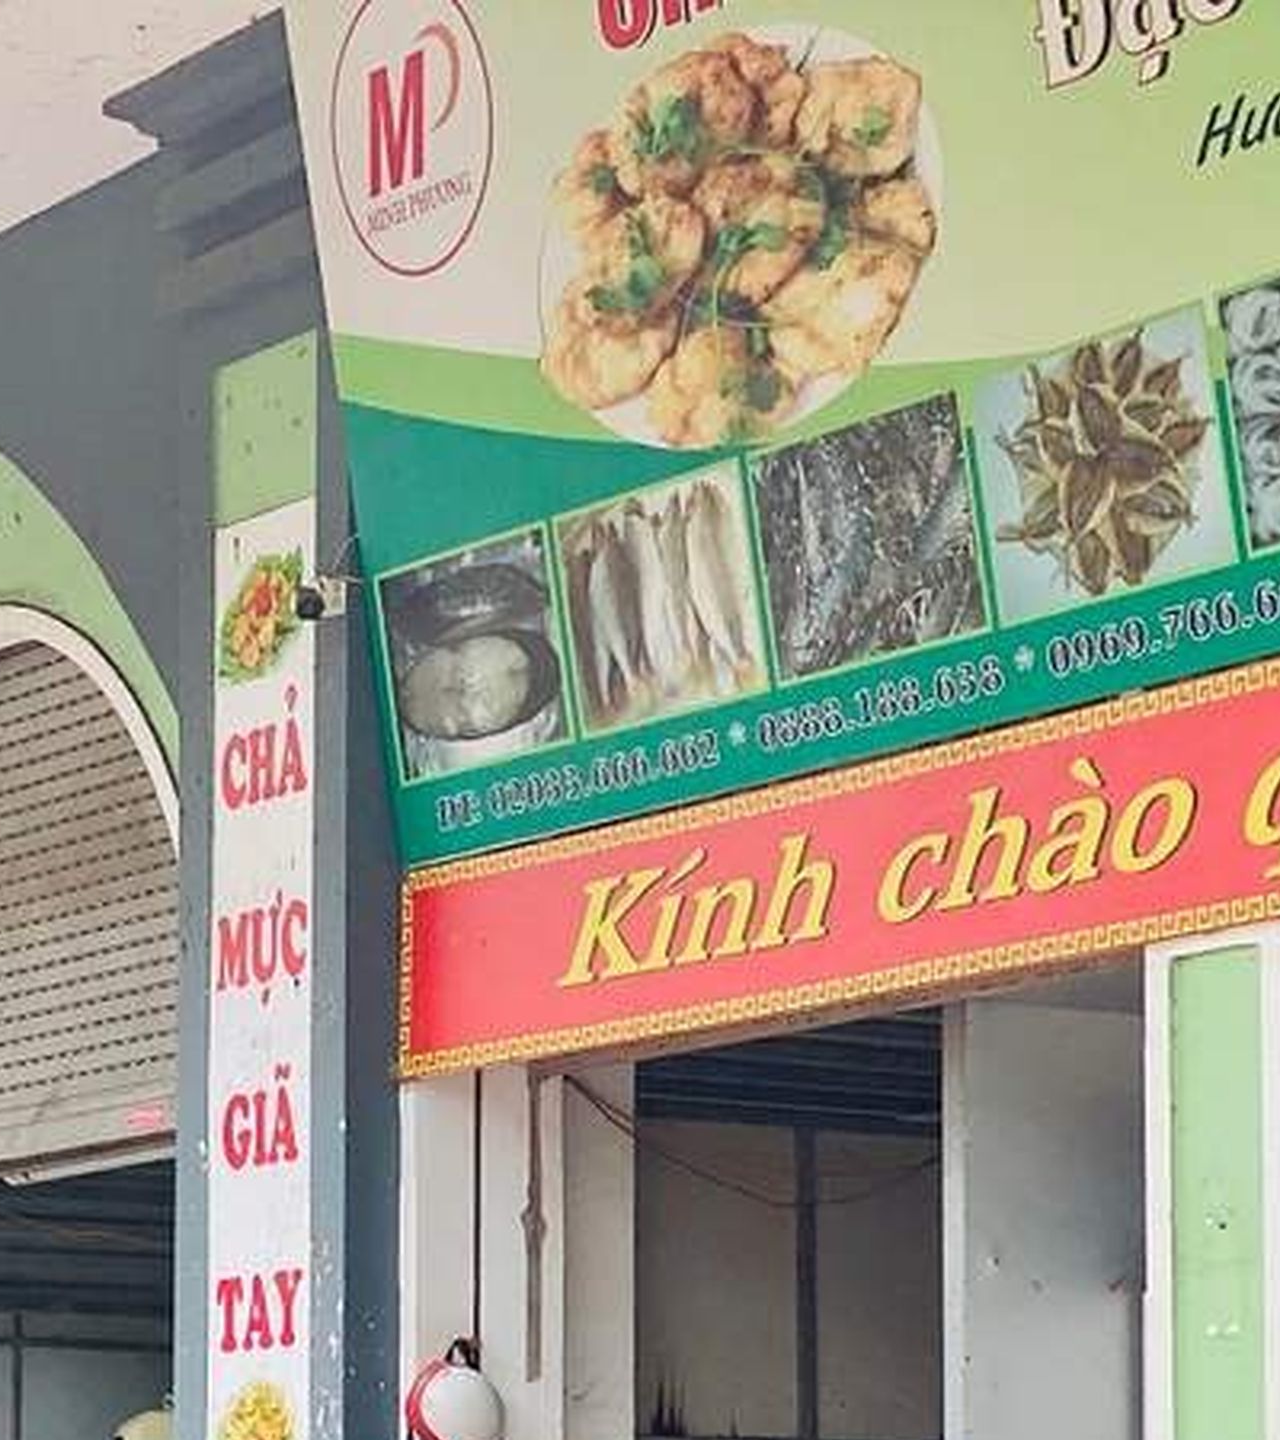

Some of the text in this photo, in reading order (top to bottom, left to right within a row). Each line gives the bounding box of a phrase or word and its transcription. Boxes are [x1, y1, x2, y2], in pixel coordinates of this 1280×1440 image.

[222, 684, 310, 812] CHẢ
[556, 832, 838, 990] Kính
[874, 756, 1198, 926] chào
[217, 888, 308, 1006] MỰC
[222, 1062, 300, 1172] GIÃ
[217, 1268, 303, 1354] TAY
